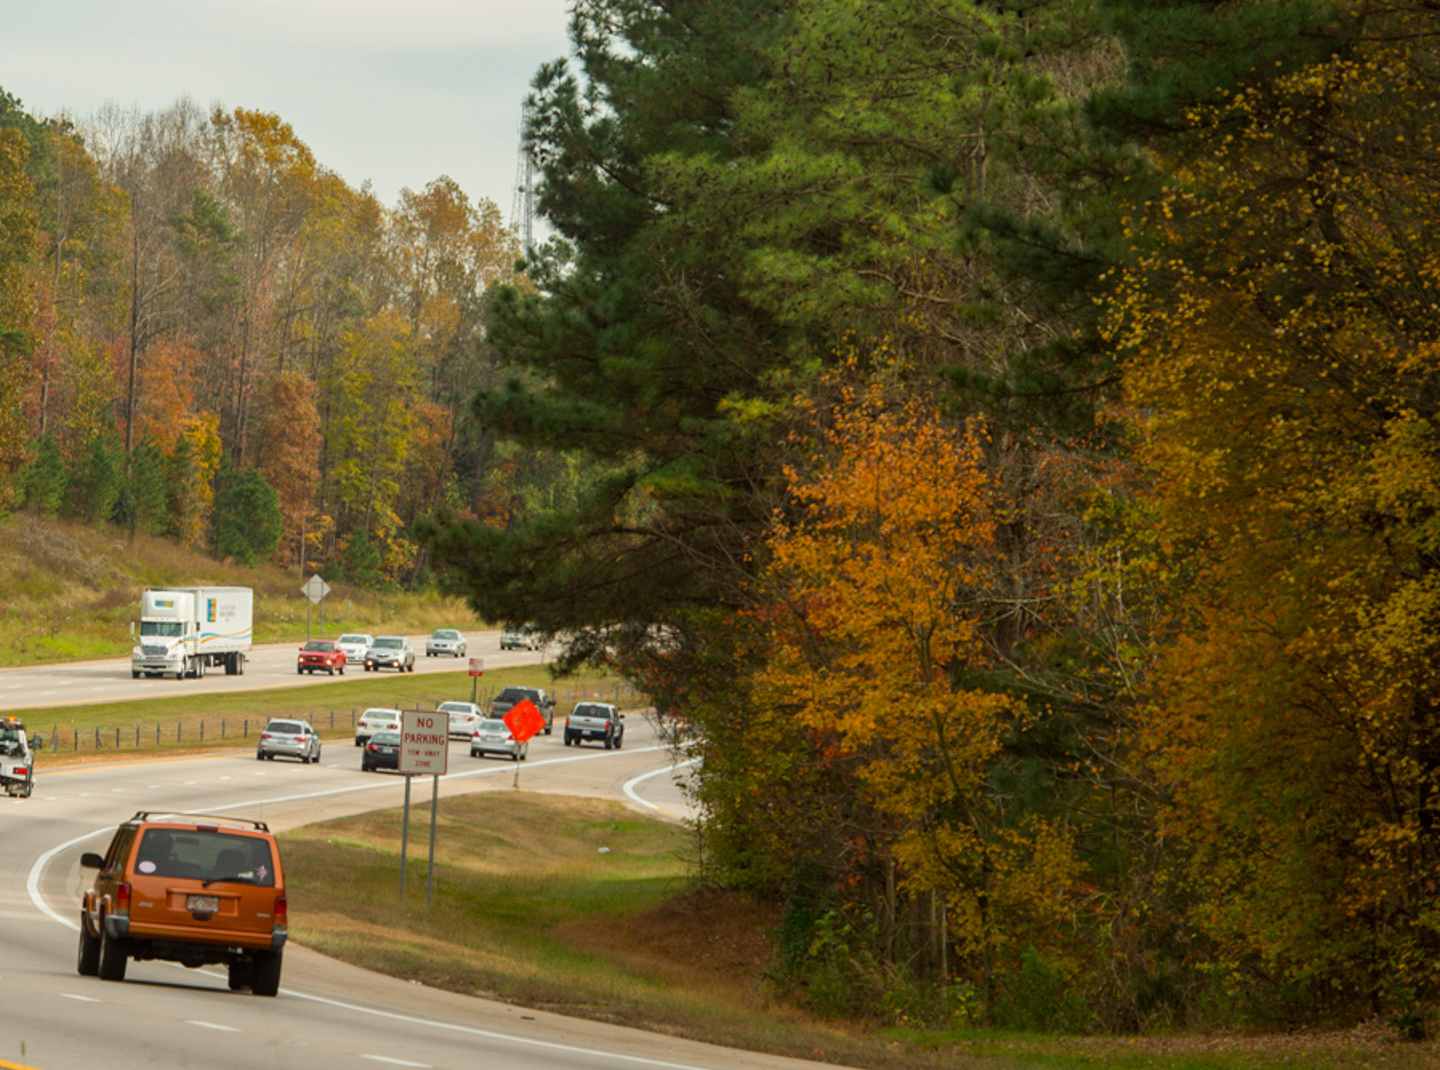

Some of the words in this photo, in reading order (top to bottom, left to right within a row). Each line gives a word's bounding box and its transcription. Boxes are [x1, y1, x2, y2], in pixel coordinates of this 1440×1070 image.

[416, 717, 434, 729] NO
[404, 733, 445, 746] PARKING
[415, 760, 431, 768] ZONE
